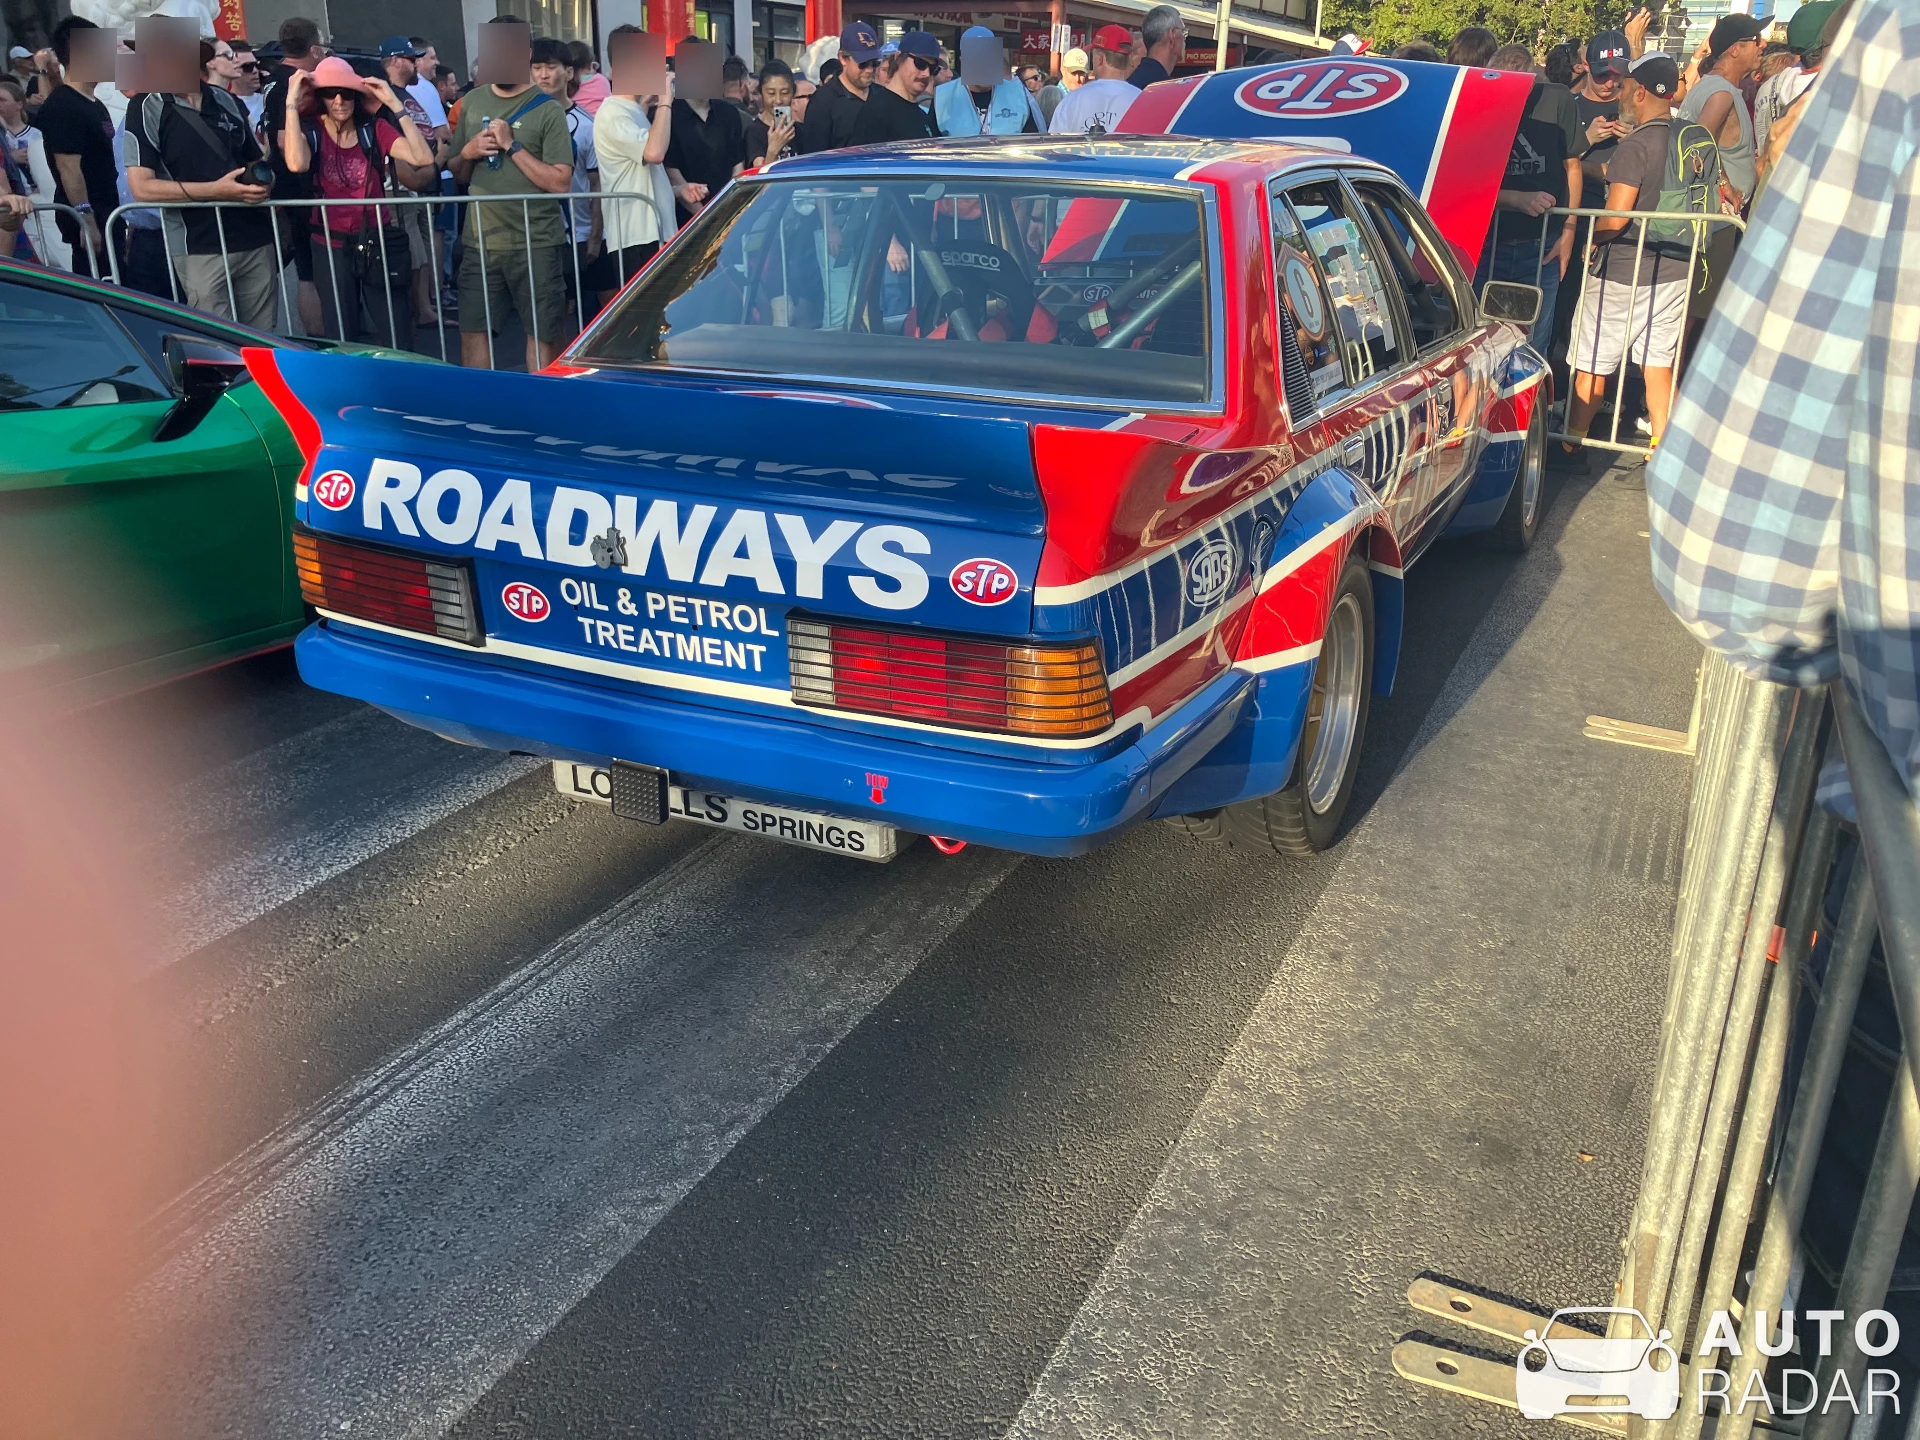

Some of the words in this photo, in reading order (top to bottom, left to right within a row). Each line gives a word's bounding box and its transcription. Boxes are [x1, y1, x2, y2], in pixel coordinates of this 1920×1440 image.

[1600, 48, 1623, 59] Mobil
[1256, 68, 1390, 110] STP
[941, 251, 1000, 269] sparco
[1087, 286, 1110, 301] STP
[1293, 268, 1314, 319] 6
[318, 475, 350, 503] STP
[362, 457, 932, 610] ROADWAYS
[957, 563, 1010, 598] STP
[508, 586, 544, 615] STP
[560, 577, 608, 612] OIL
[617, 588, 639, 617] &
[646, 592, 780, 638] PETROL
[577, 615, 767, 673] TREATMENT
[865, 772, 889, 789] TOW
[742, 809, 865, 852] SPRINGS
